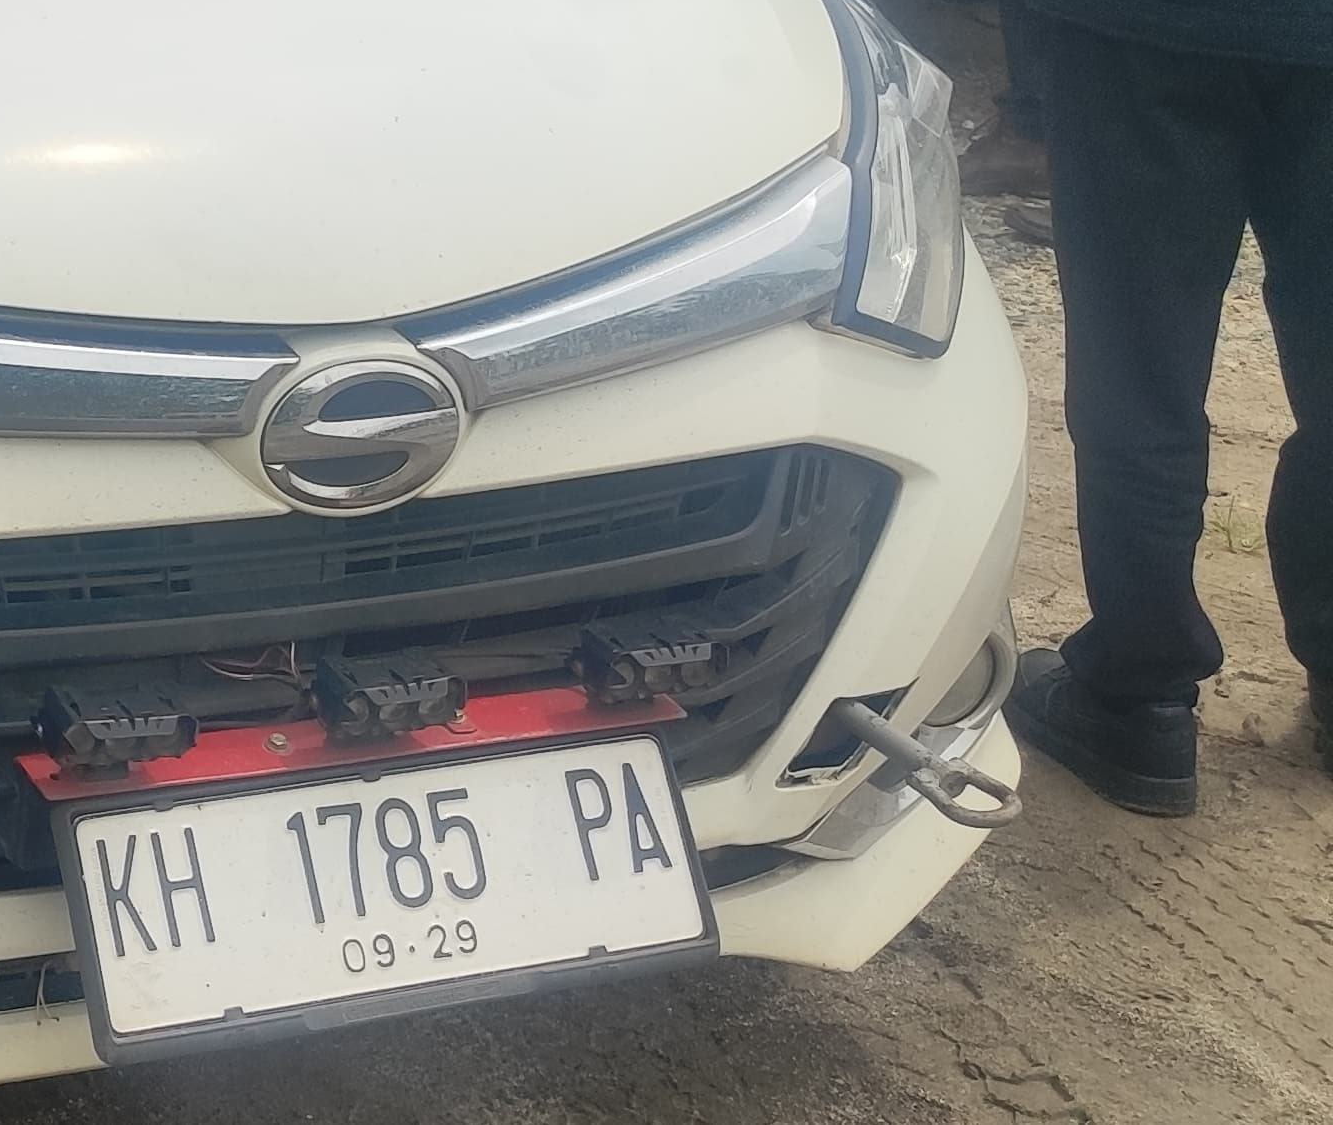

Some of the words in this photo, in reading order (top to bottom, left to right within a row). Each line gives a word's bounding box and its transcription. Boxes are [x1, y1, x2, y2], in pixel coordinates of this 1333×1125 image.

[95, 827, 216, 959] KH
[286, 787, 488, 926] 1785
[564, 761, 673, 881] PA
